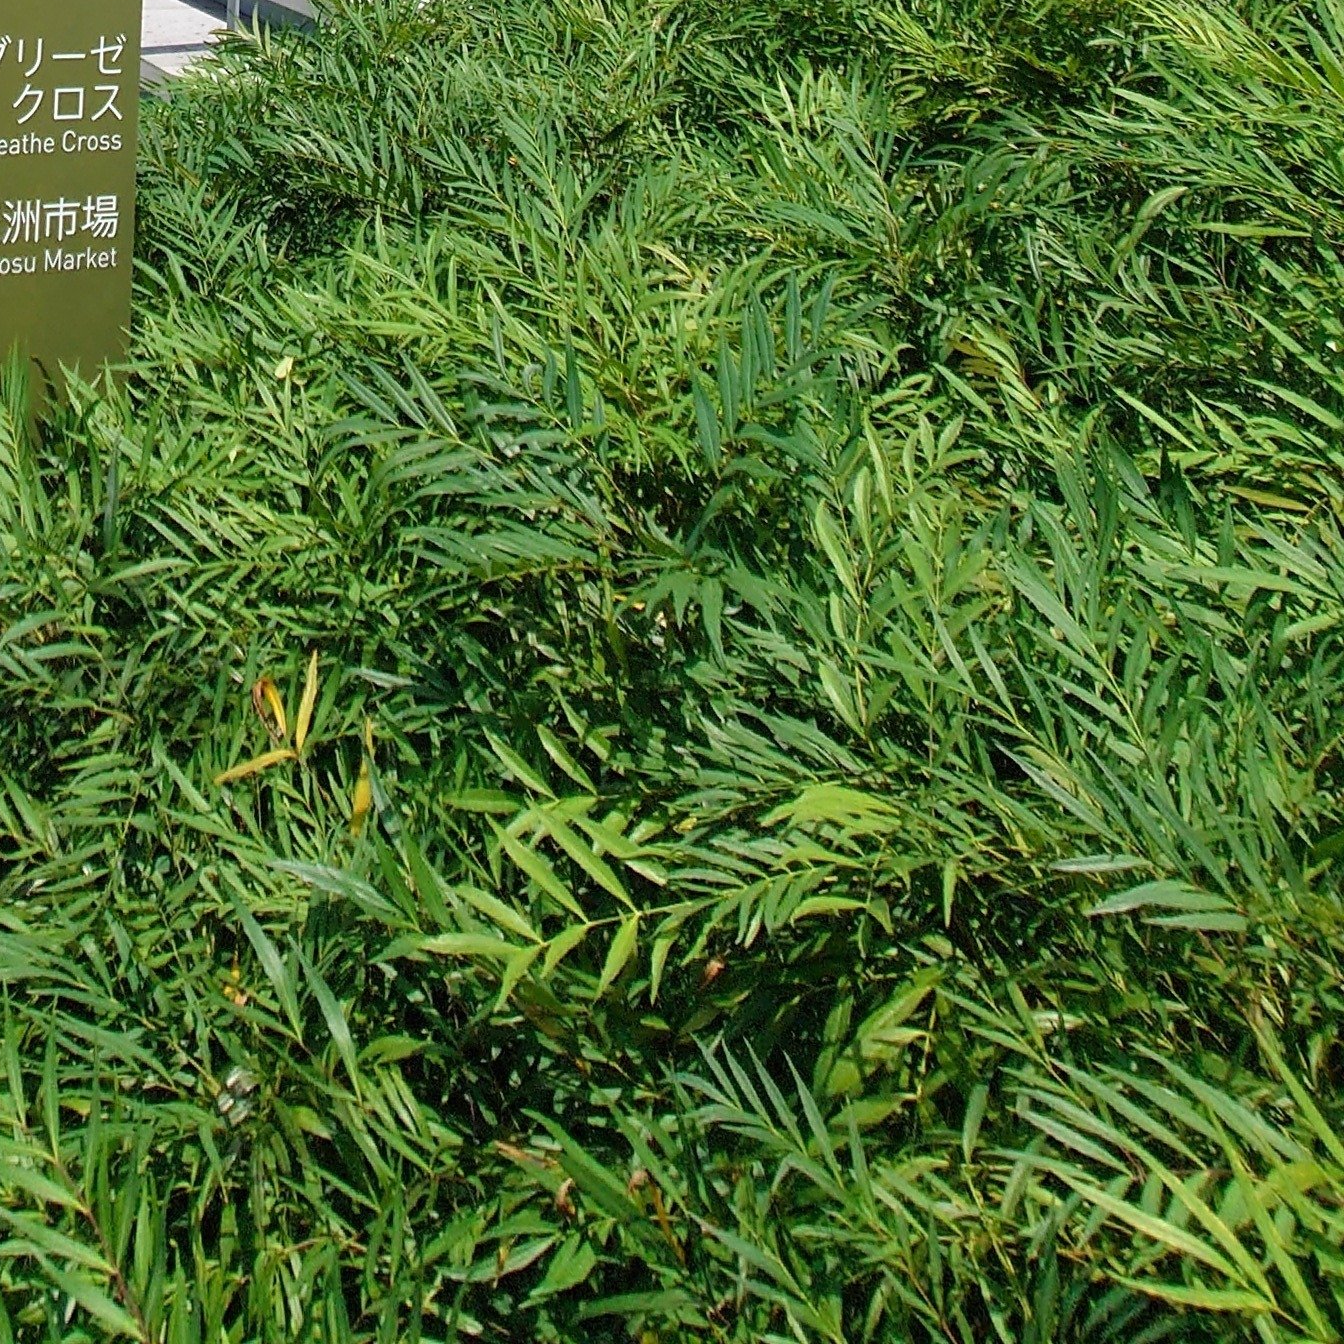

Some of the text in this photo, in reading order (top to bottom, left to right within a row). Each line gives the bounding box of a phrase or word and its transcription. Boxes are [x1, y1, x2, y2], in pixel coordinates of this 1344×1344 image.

[11, 82, 123, 125] クロス
[61, 129, 123, 153] Cross
[43, 246, 118, 272] Market
